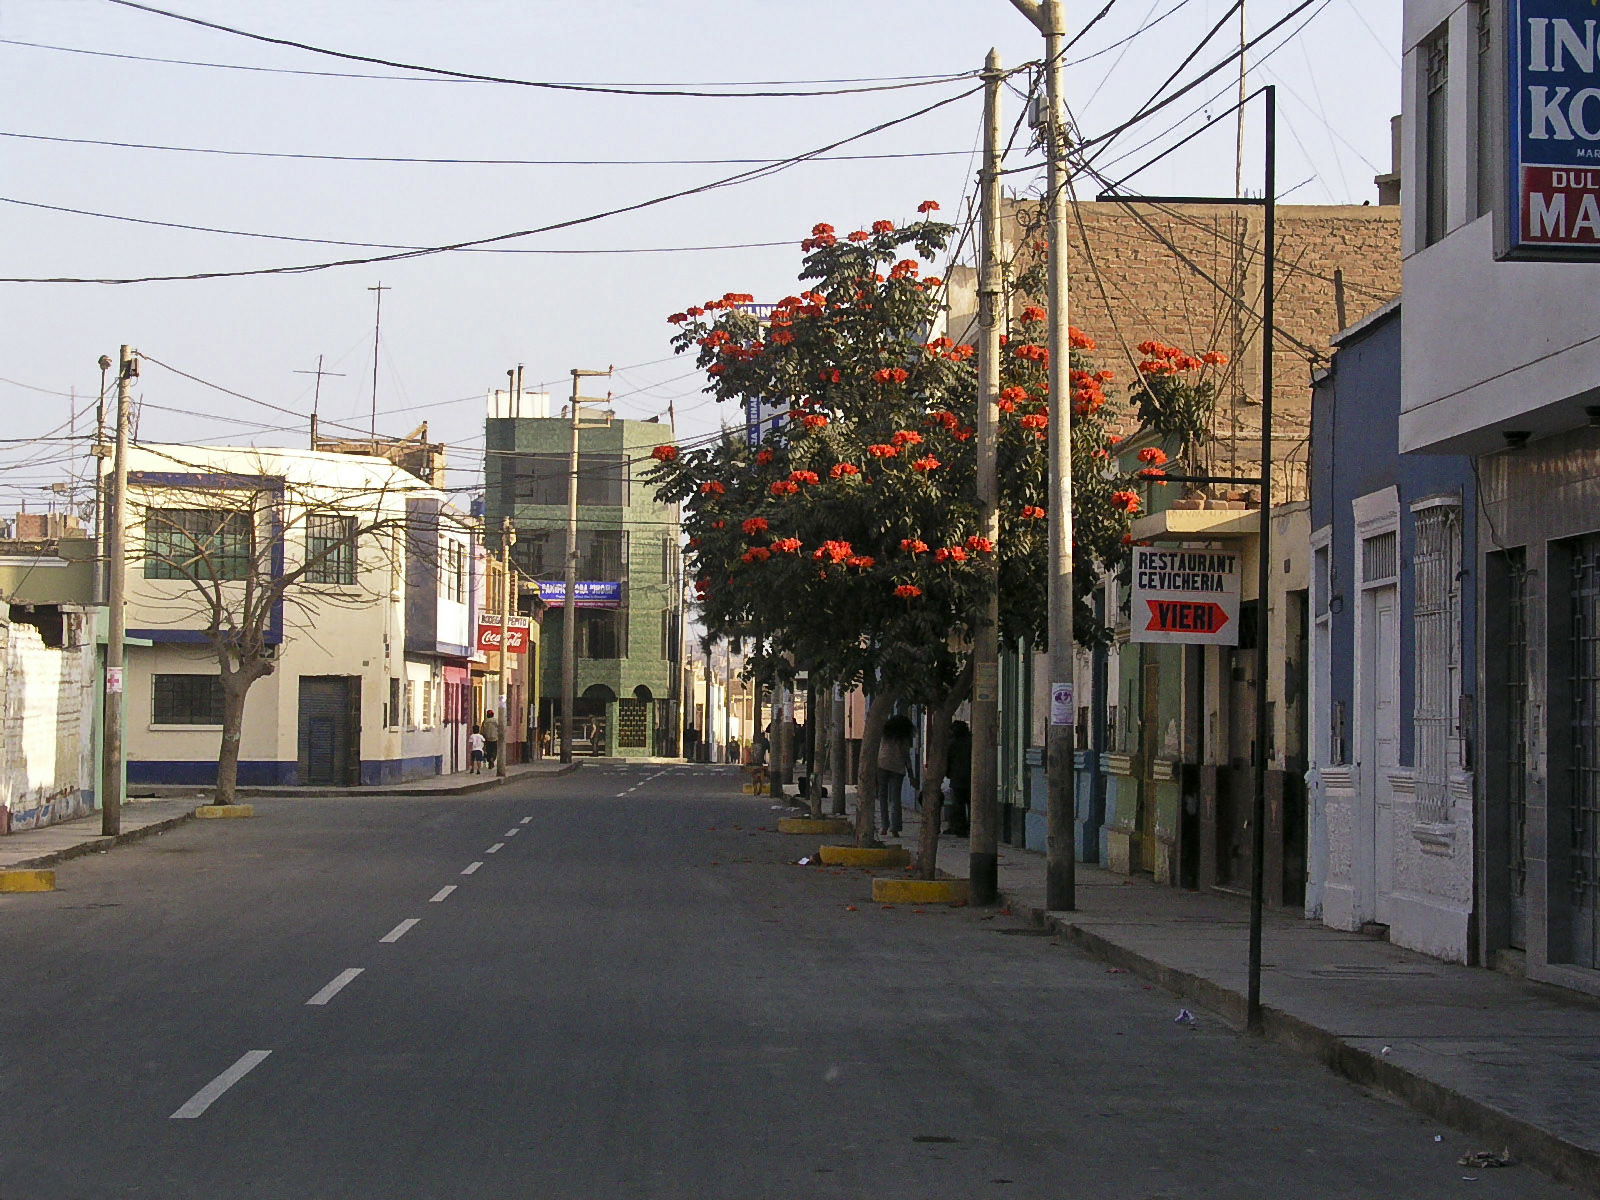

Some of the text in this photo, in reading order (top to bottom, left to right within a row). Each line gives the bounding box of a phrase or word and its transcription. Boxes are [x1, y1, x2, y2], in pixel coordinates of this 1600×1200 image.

[1528, 18, 1600, 73] IN
[1551, 171, 1600, 189] DUL
[1529, 192, 1600, 239] MA
[1138, 552, 1235, 573] RESTAURANT
[1138, 571, 1224, 591] CEVICHERIA
[1158, 602, 1215, 630] VIERI
